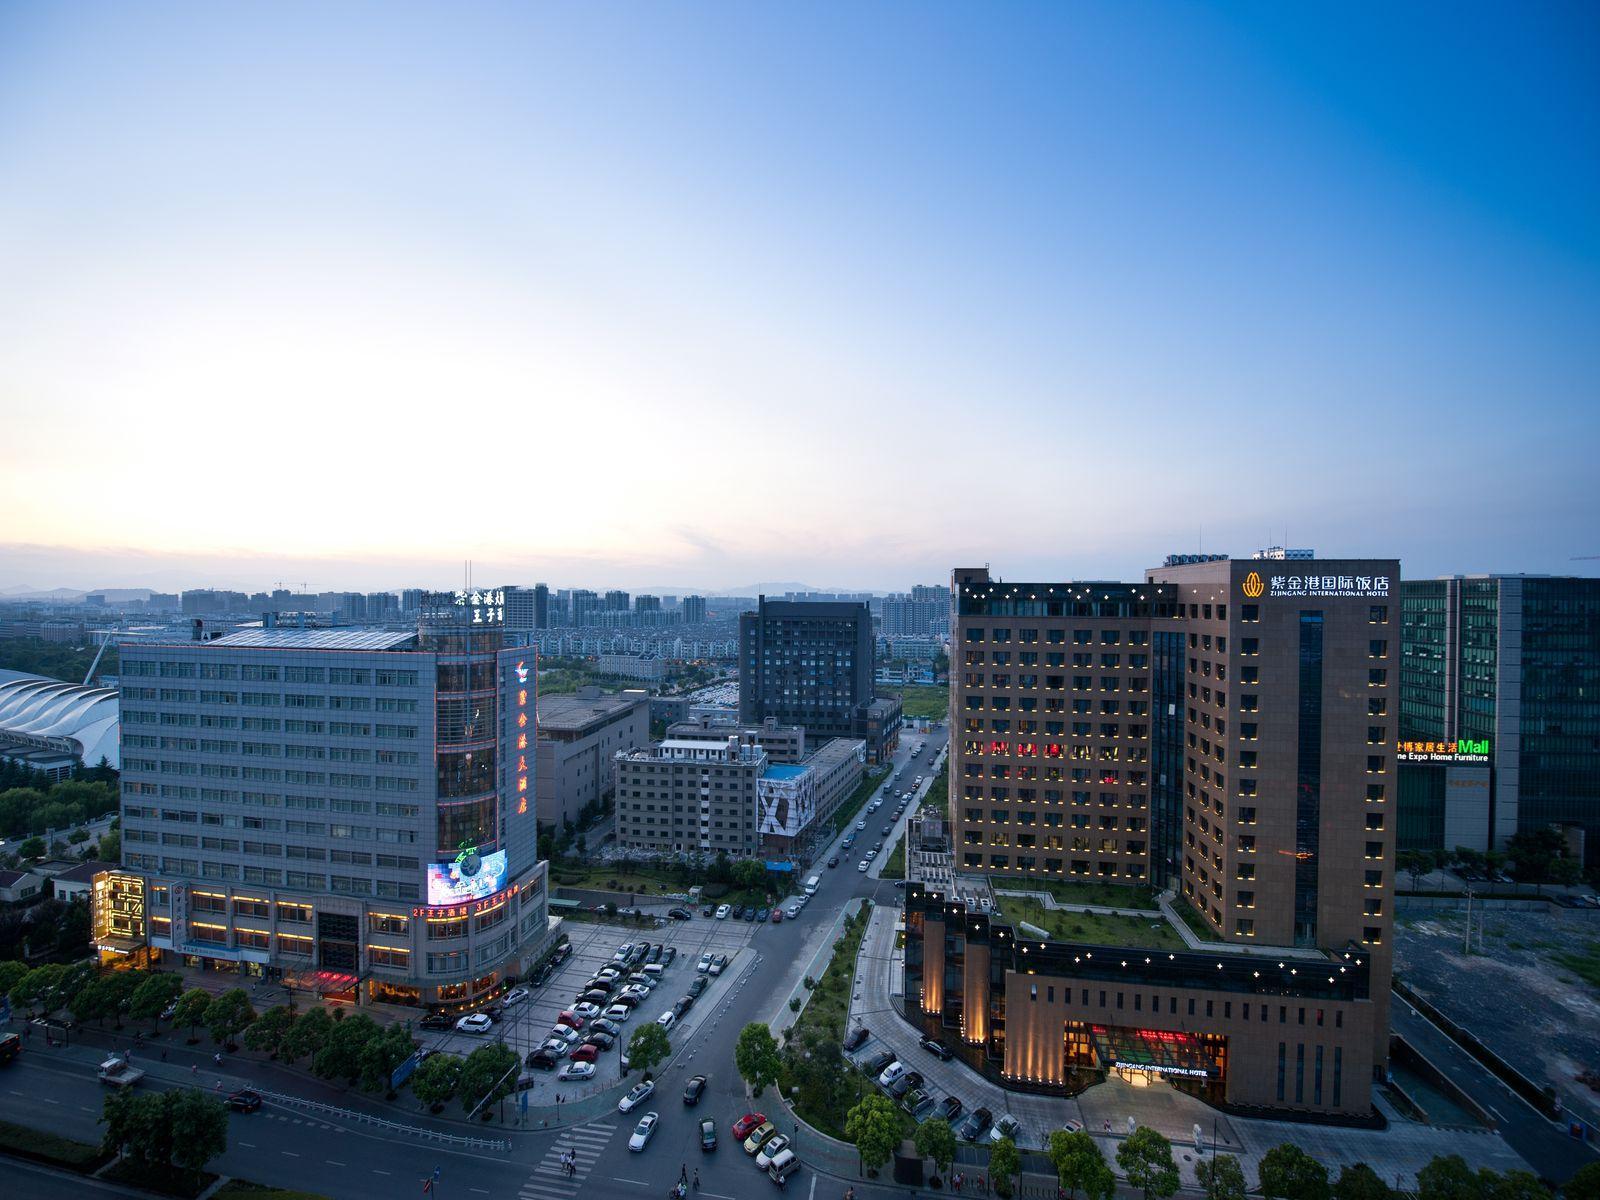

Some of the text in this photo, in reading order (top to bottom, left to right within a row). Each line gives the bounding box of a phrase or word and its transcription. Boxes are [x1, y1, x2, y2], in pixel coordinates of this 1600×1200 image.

[1270, 575, 1390, 590] 紫金港国际饭店
[1458, 739, 1489, 754] Mall
[1408, 752, 1428, 762] Expo
[1430, 753, 1453, 761] Home
[1454, 753, 1489, 762] Furniture
[1115, 1061, 1208, 1077] ZIJINGANG INTERNATIONAL HOTEL
